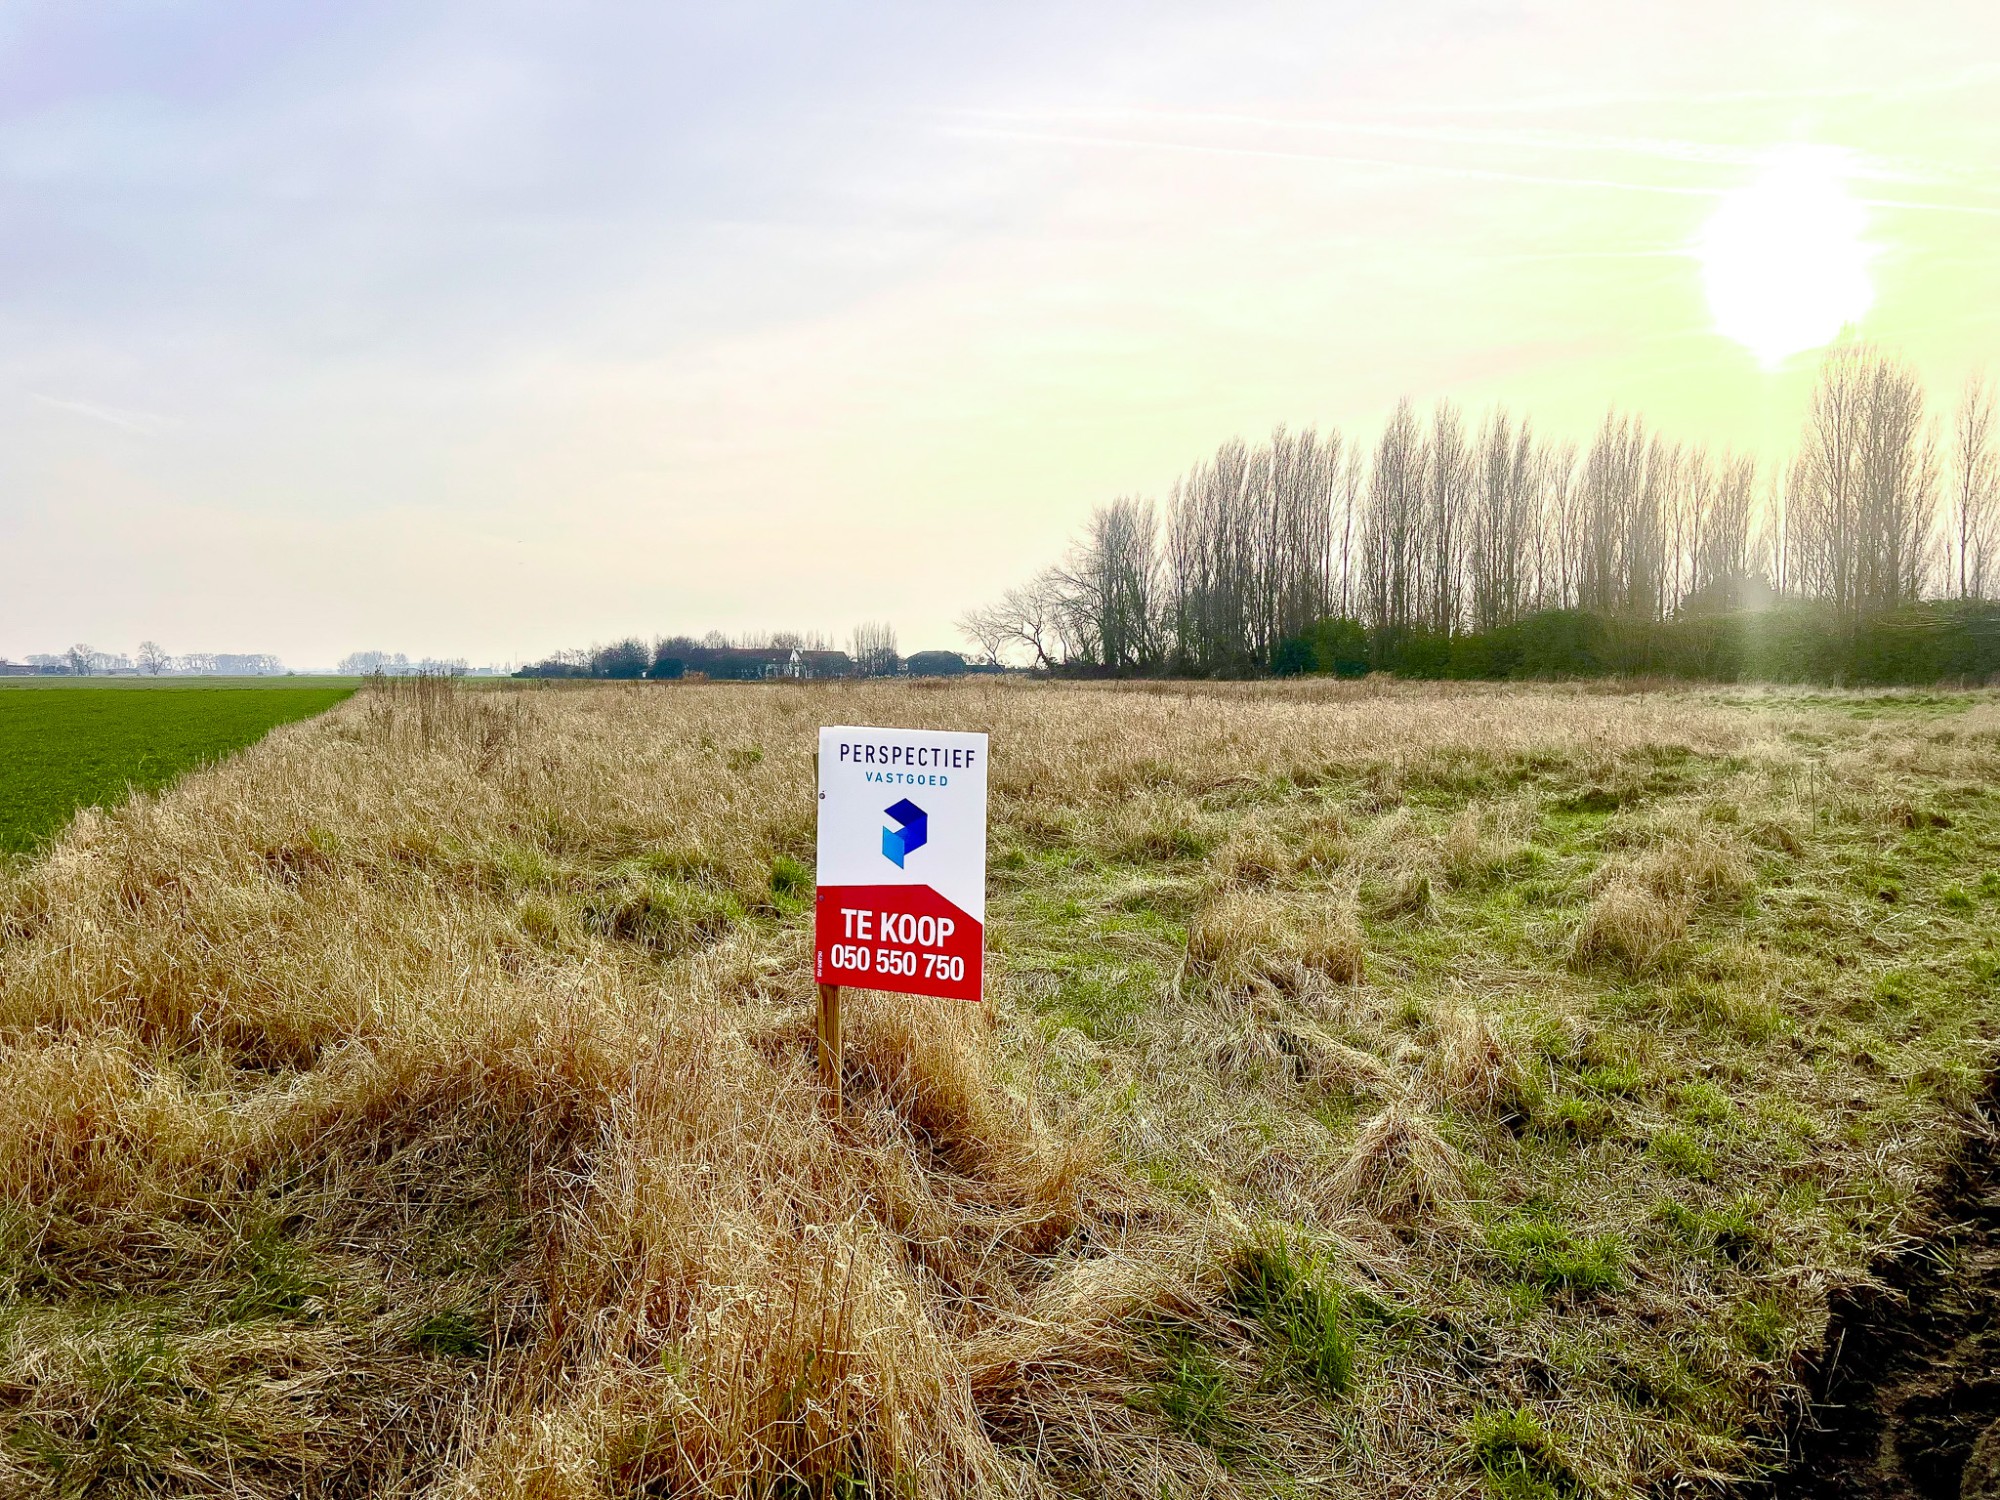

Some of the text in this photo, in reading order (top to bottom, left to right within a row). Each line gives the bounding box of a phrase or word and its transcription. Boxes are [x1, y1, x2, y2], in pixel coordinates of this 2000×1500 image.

[840, 743, 975, 769] PERSPECTIEF
[865, 771, 948, 786] VASTGOED
[840, 908, 955, 948] TE KOOP
[831, 944, 965, 981] 050 550 750
